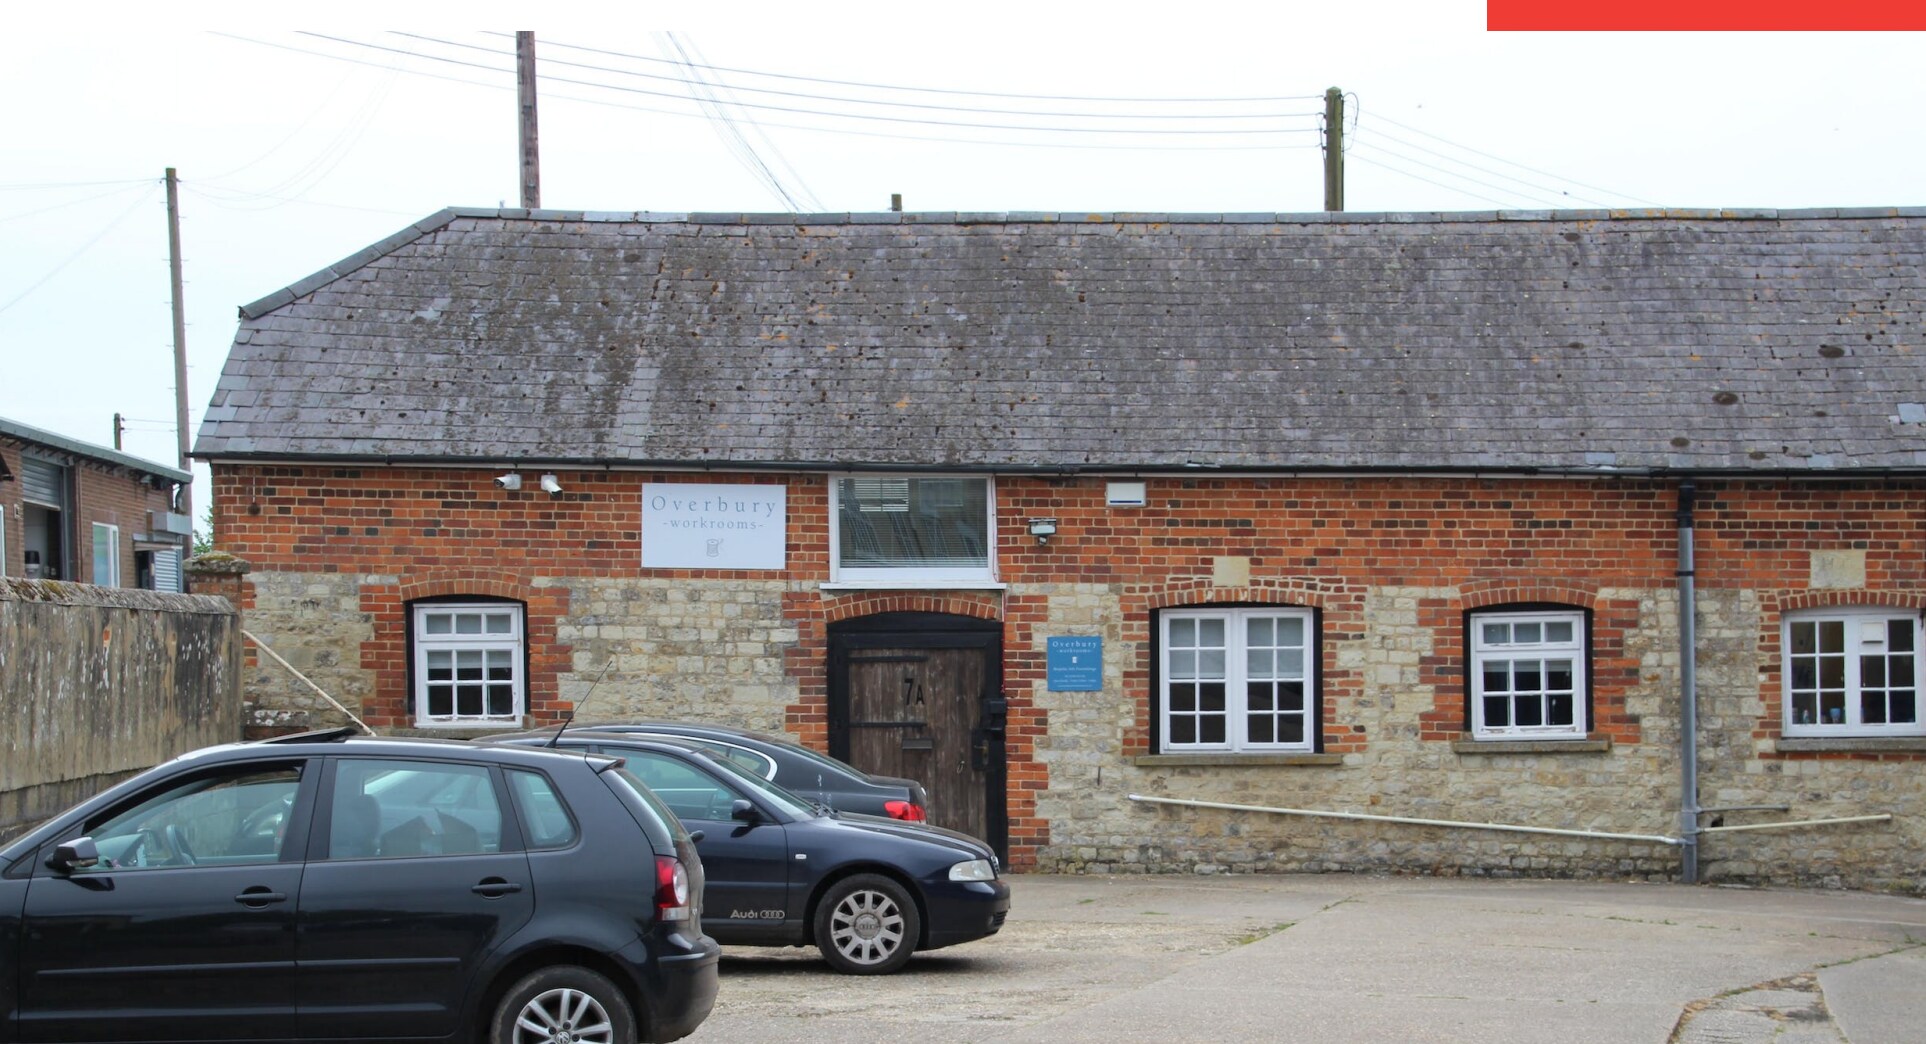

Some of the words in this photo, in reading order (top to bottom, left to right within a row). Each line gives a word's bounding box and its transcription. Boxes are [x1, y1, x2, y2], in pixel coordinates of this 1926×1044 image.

[651, 495, 776, 517] Overbury
[1052, 641, 1096, 649] Overbury
[904, 678, 925, 706] 7A
[730, 909, 758, 919] Audi
